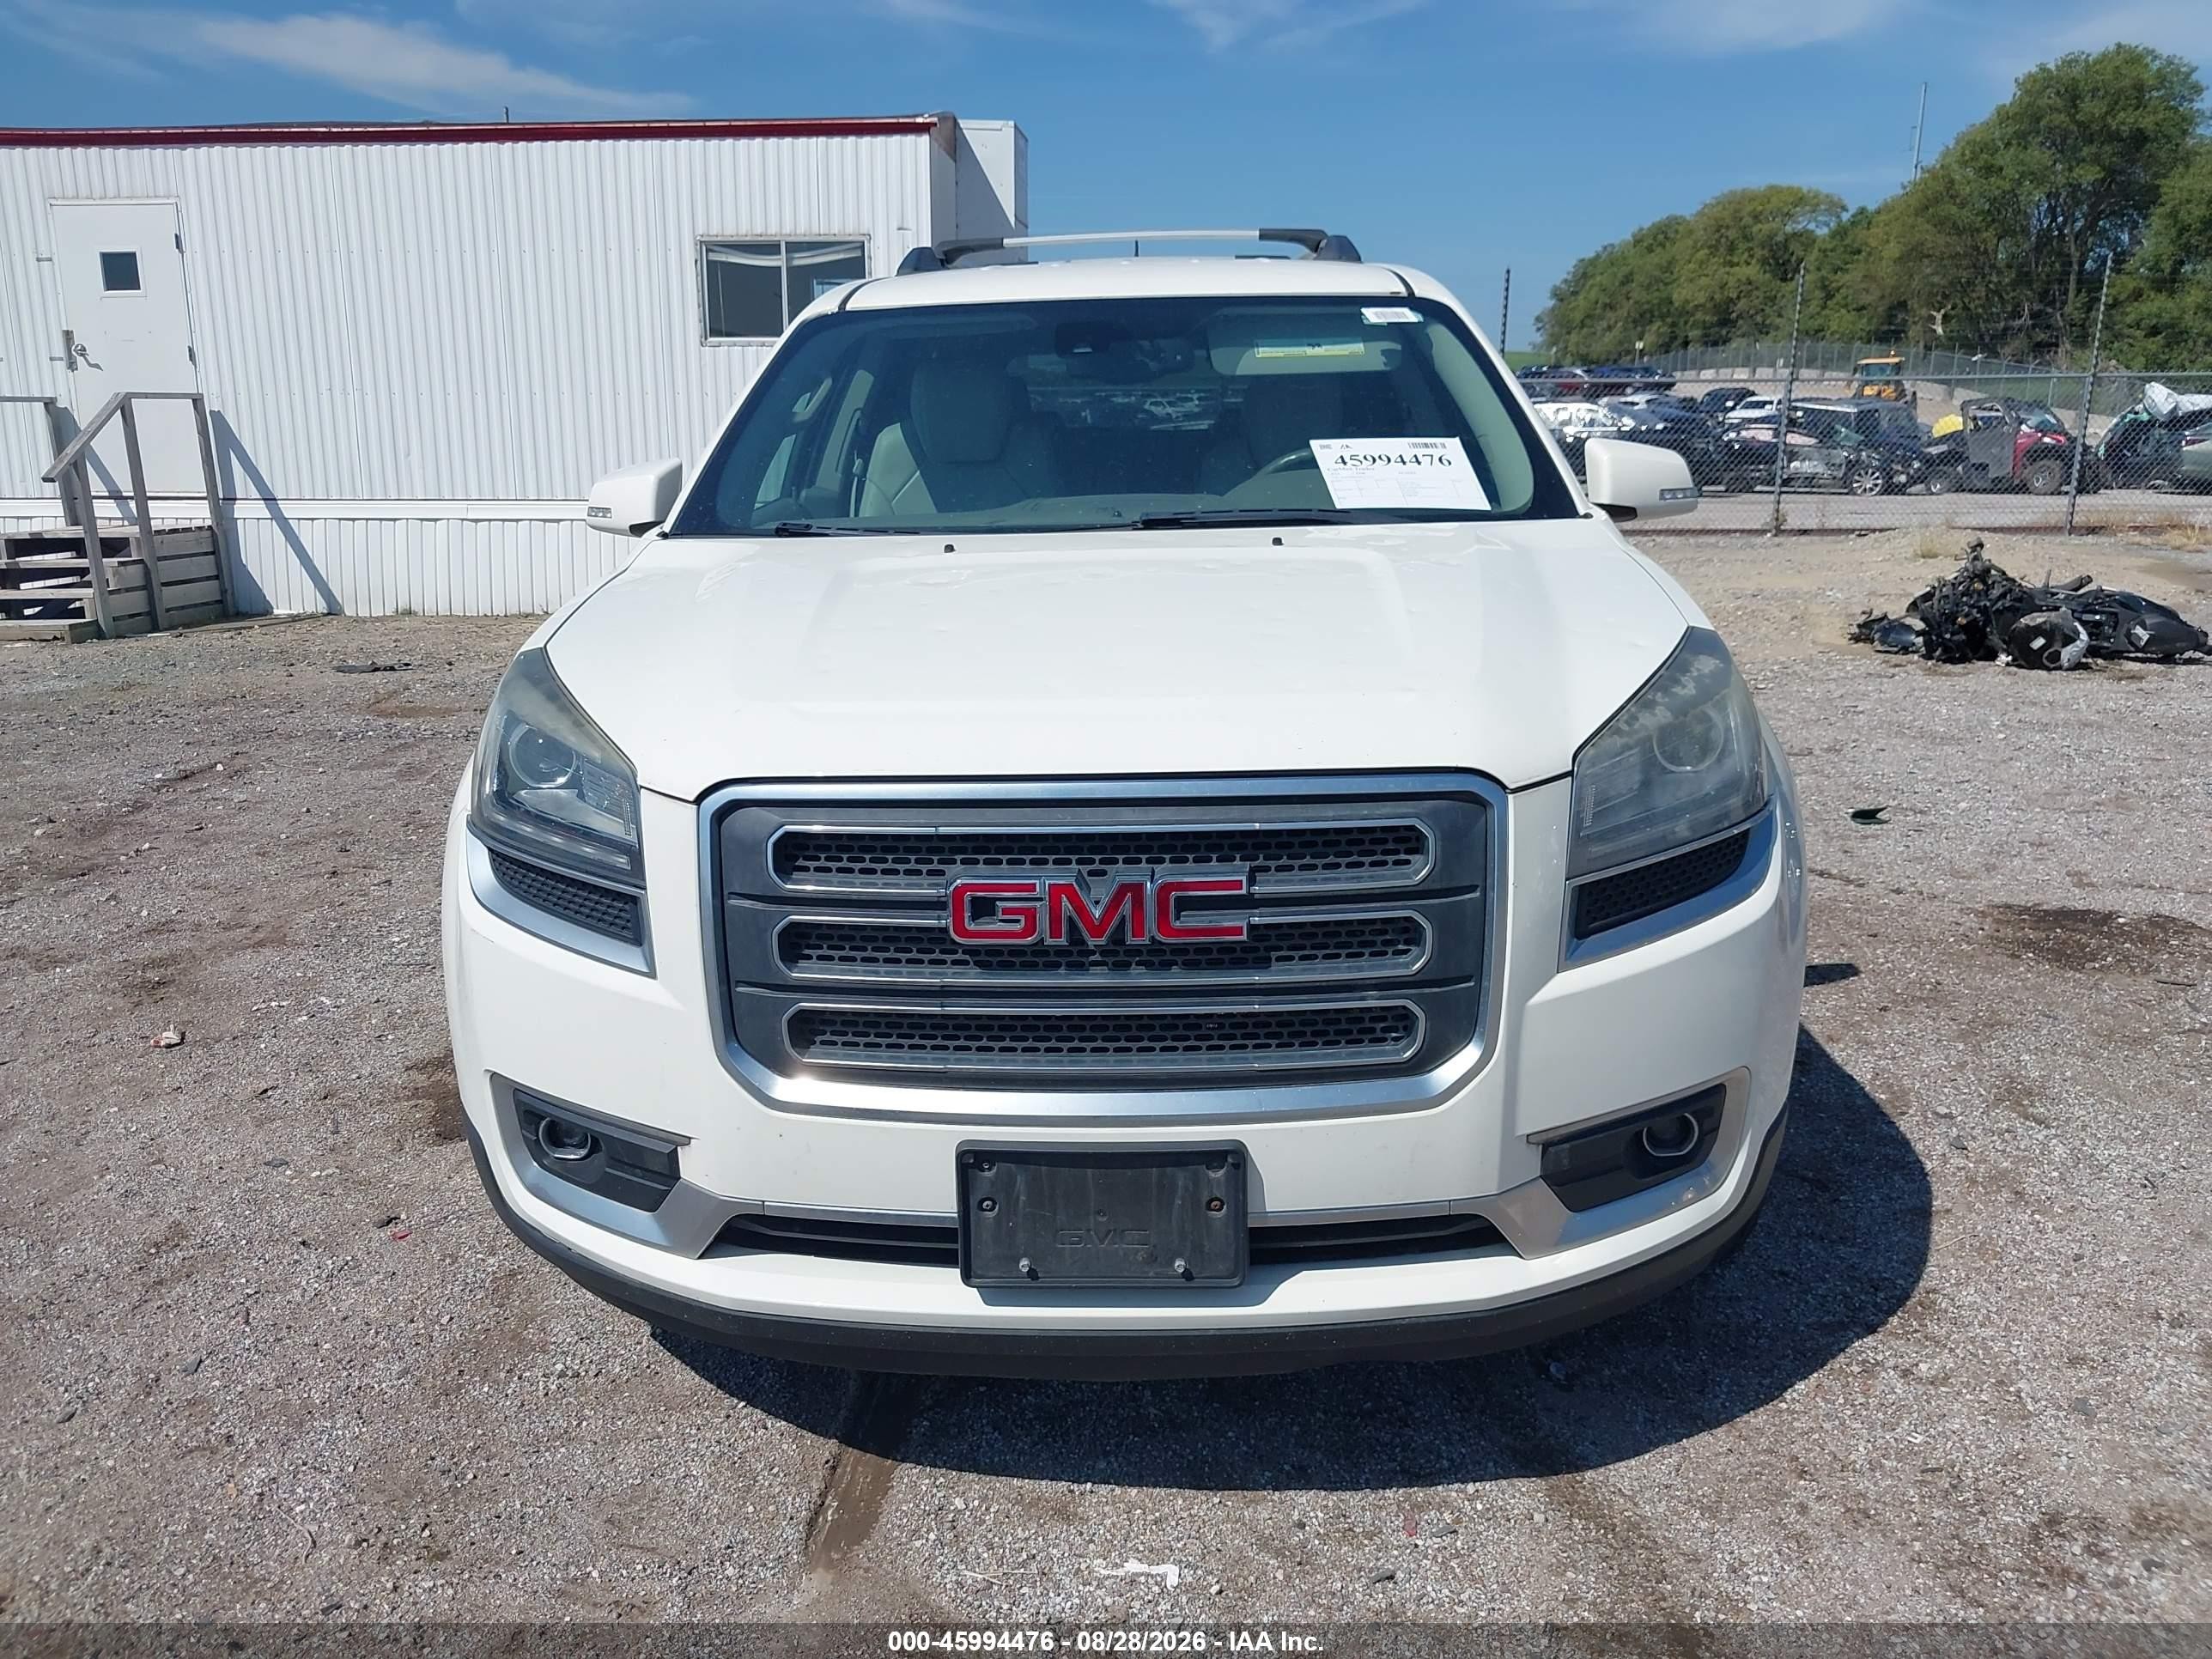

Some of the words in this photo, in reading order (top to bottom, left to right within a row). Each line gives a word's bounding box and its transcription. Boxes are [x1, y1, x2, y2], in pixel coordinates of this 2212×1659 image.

[1334, 453, 1452, 467] 45994476
[949, 875, 1249, 945] GMC
[1057, 1229, 1150, 1248] GMC
